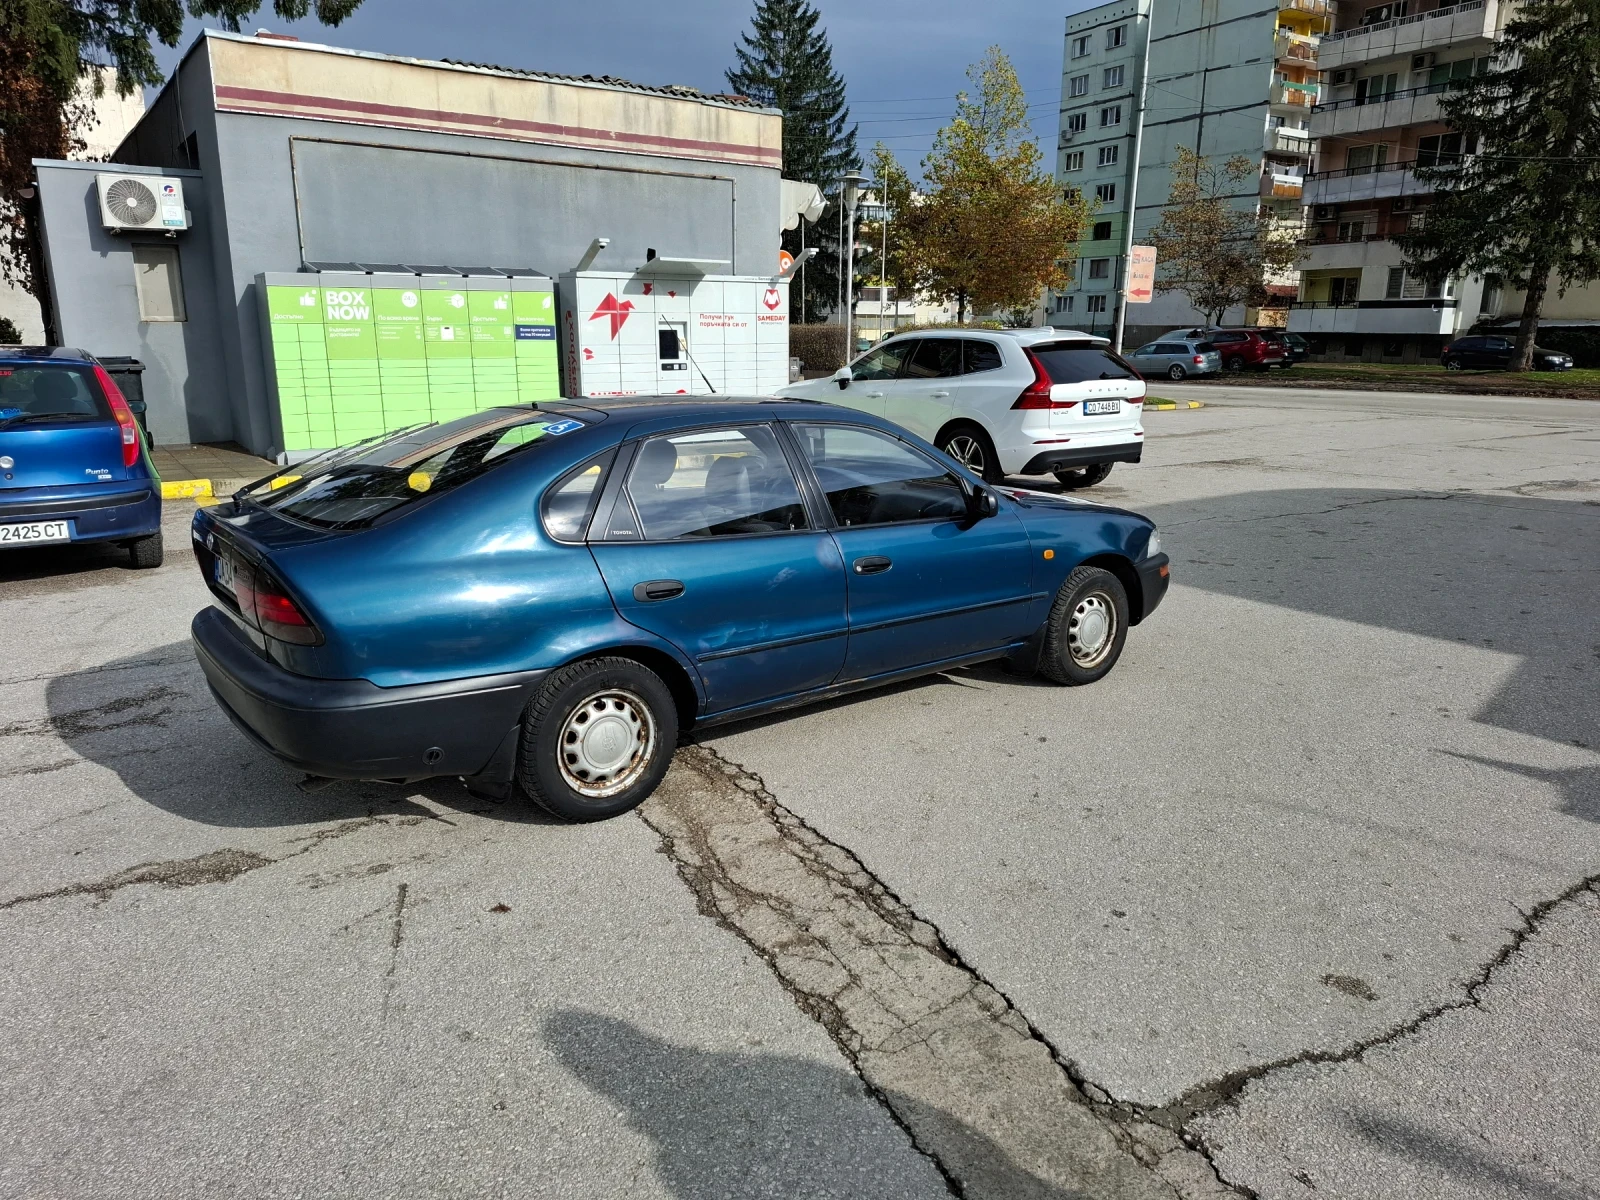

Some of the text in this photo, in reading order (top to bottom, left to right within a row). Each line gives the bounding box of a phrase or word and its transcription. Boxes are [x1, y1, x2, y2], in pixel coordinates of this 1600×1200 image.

[325, 290, 366, 306] BOX
[327, 306, 370, 320] NOW
[700, 313, 722, 321] Получи
